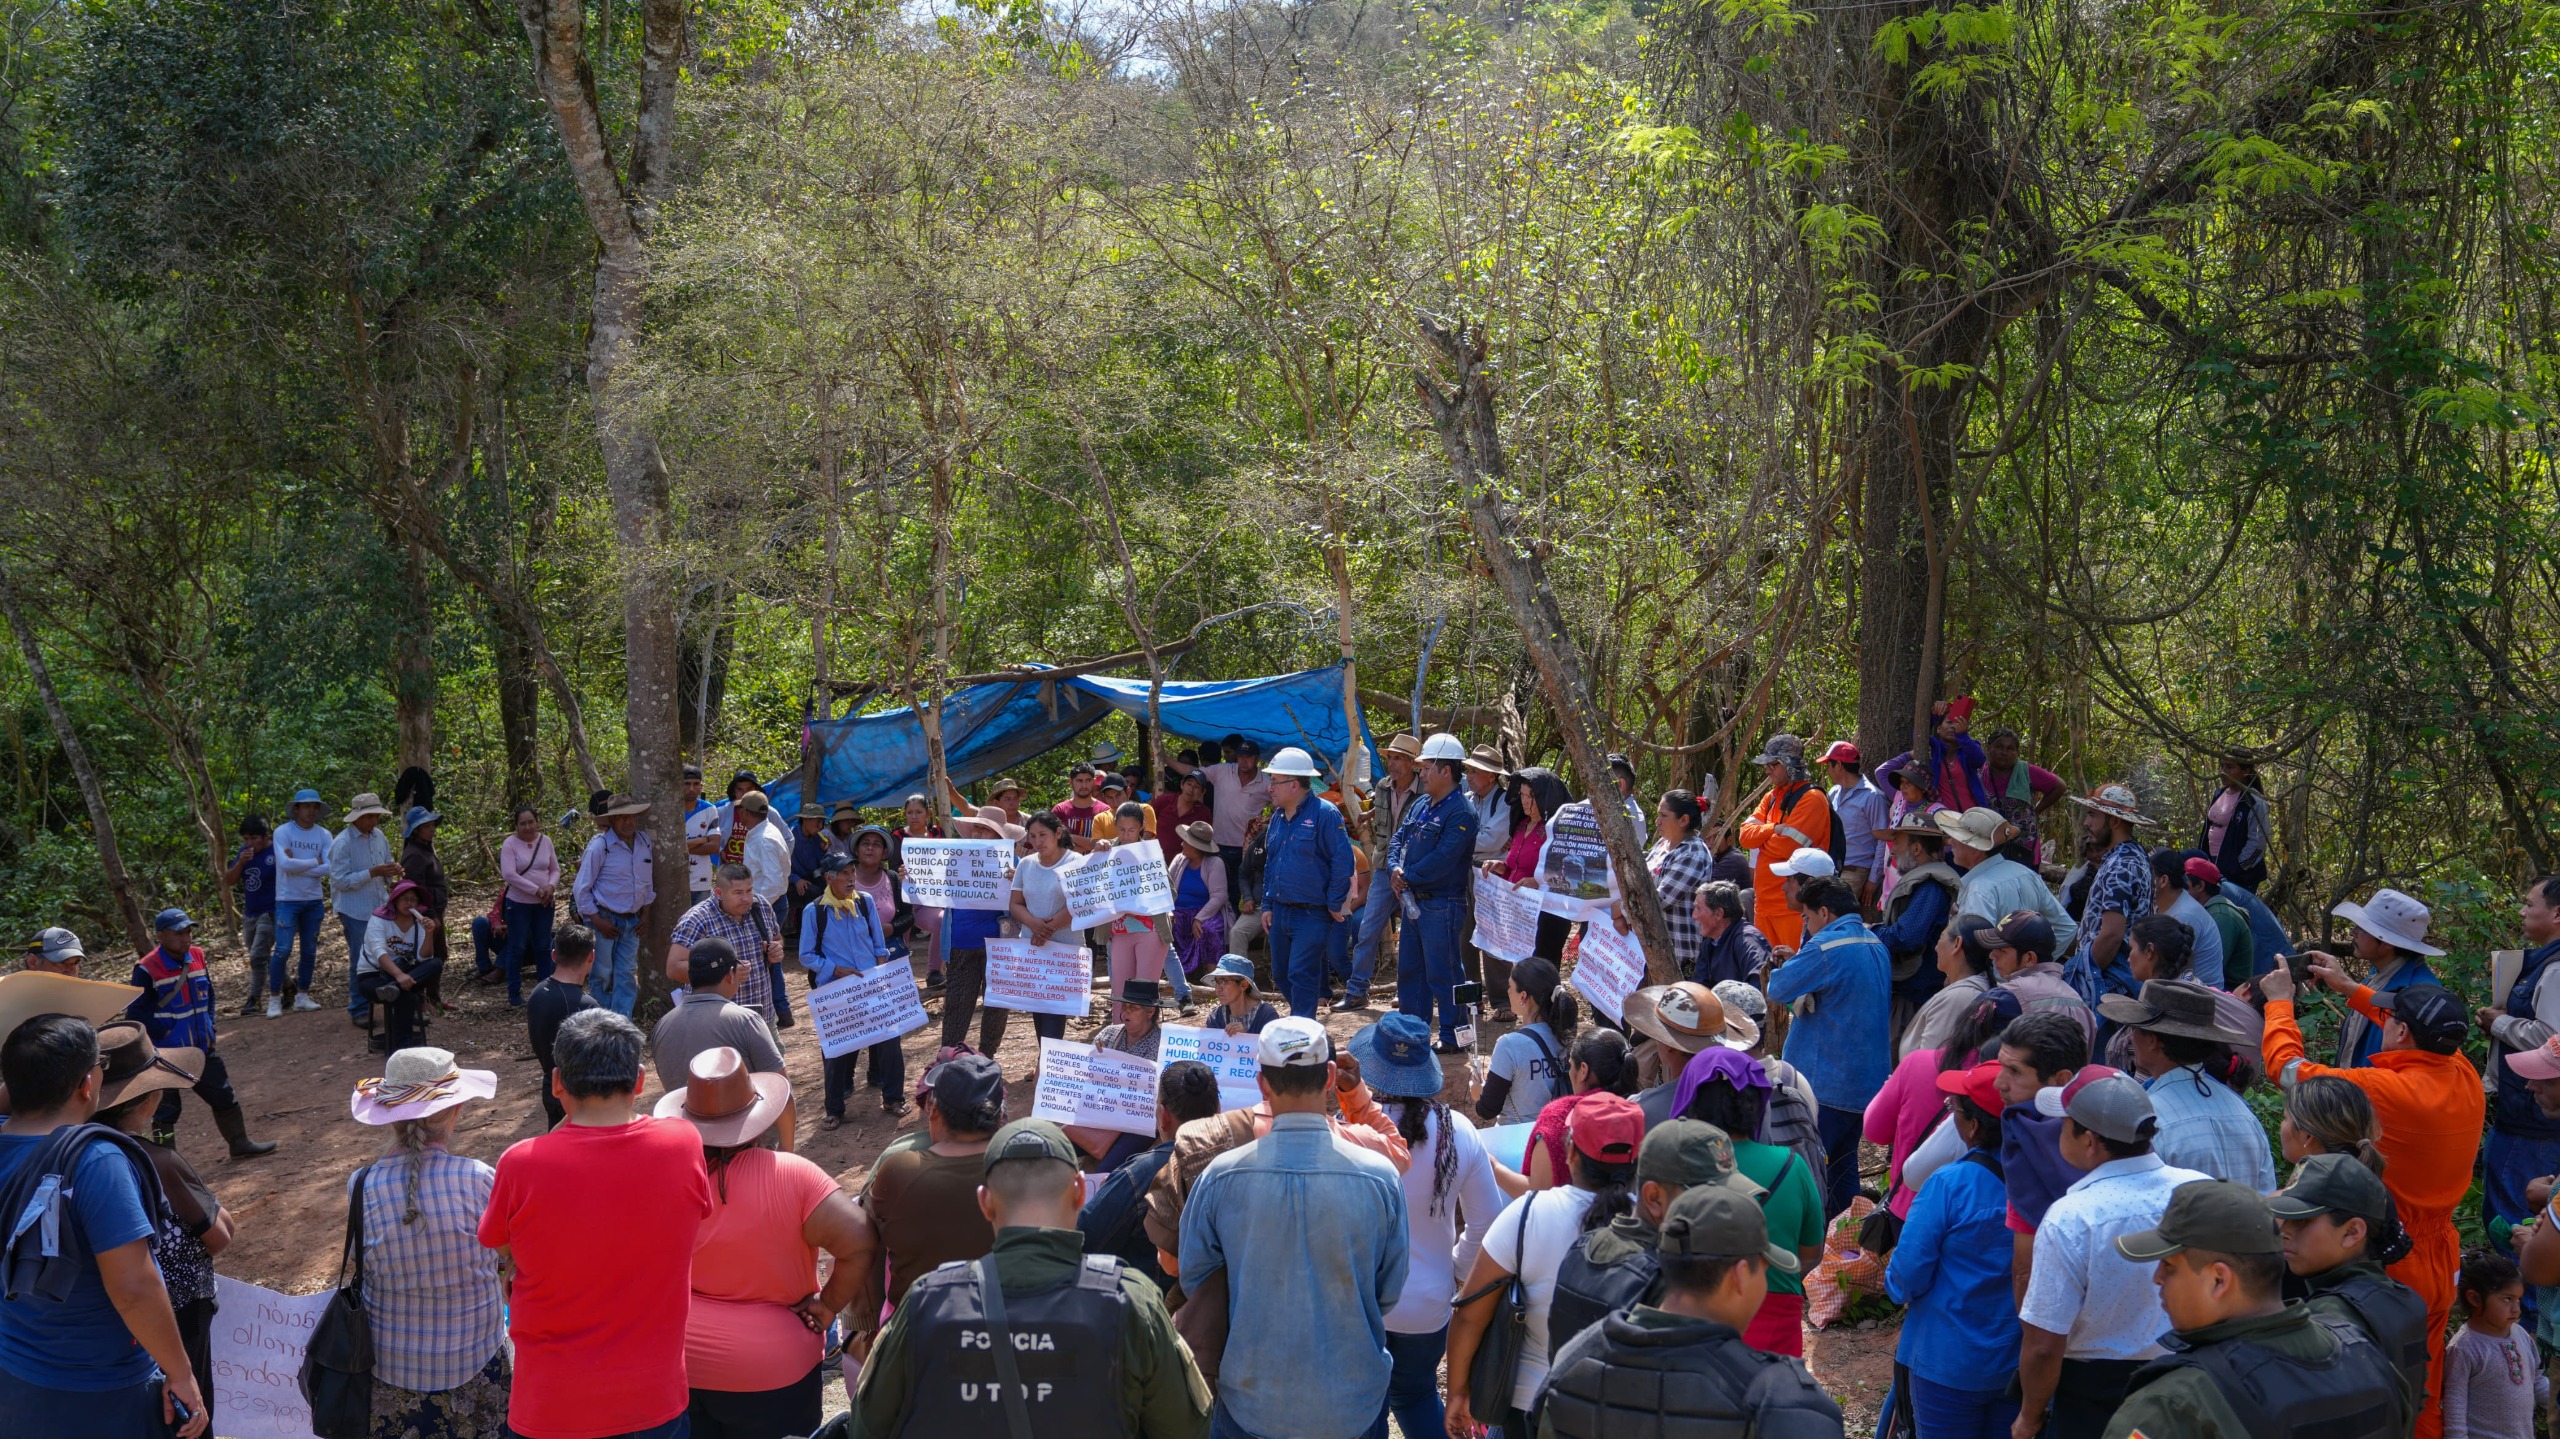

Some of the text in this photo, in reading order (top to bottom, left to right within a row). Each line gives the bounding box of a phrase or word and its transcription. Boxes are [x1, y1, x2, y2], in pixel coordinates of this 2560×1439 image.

[907, 847, 936, 855] DOMO
[943, 848, 962, 856] OSO
[987, 850, 1011, 858] ESTA
[1577, 842, 1606, 851] MIENTRAS
[908, 858, 957, 866] HUBICADO
[909, 878, 955, 886] INTEGRAL
[973, 881, 998, 889] CUEN
[972, 871, 1009, 879] MANEJO
[1066, 861, 1162, 889] NUESTRAS CUENCAS
[908, 887, 927, 895] CAS
[945, 890, 999, 900] CHIQUIACA.
[1072, 882, 1167, 909] EL AGUA QUE NOS DA
[1084, 886, 1101, 895] QUE
[1103, 882, 1115, 890] DE
[1025, 958, 1055, 966] NUESTRA
[1053, 952, 1089, 961] REUNIONES
[1005, 965, 1039, 973] QUEREMOS
[1046, 969, 1089, 977] PETROLERAS
[815, 985, 862, 1004] REPUDIAMOS
[869, 966, 909, 986] RECHAZAMOS
[878, 983, 914, 1001] PETROLERA
[992, 979, 1035, 988] AGRICULTORES
[1045, 984, 1087, 993] GANADEROS
[835, 1011, 869, 1025] NUESTRA
[892, 991, 917, 1005] PORQUE
[825, 1021, 865, 1039] NOSOTROS
[869, 1009, 896, 1023] VIVIMOS
[828, 1026, 878, 1047] AGRICULTURA
[1168, 1036, 1201, 1048] DOMO
[1237, 1045, 1250, 1054] X3
[1166, 1049, 1254, 1066] HUBICADO EN
[1046, 1058, 1080, 1068] HACERLES
[1088, 1065, 1120, 1076] CONOCER
[1127, 1072, 1141, 1080] QUE
[1046, 1065, 1064, 1073] POSO
[1075, 1070, 1094, 1078] DOMO
[1044, 1079, 1084, 1091] CABECERAS
[1046, 1072, 1085, 1083] ENCUENTRA
[1092, 1080, 1121, 1089] UBICADO
[1041, 1094, 1056, 1102] VIDA
[1083, 1102, 1115, 1112] NUESTRO
[1042, 1087, 1082, 1099] VERTIENTES
[1099, 1097, 1118, 1105] AGUA
[1140, 1104, 1154, 1112] DAN
[961, 1330, 1054, 1351] POCIA
